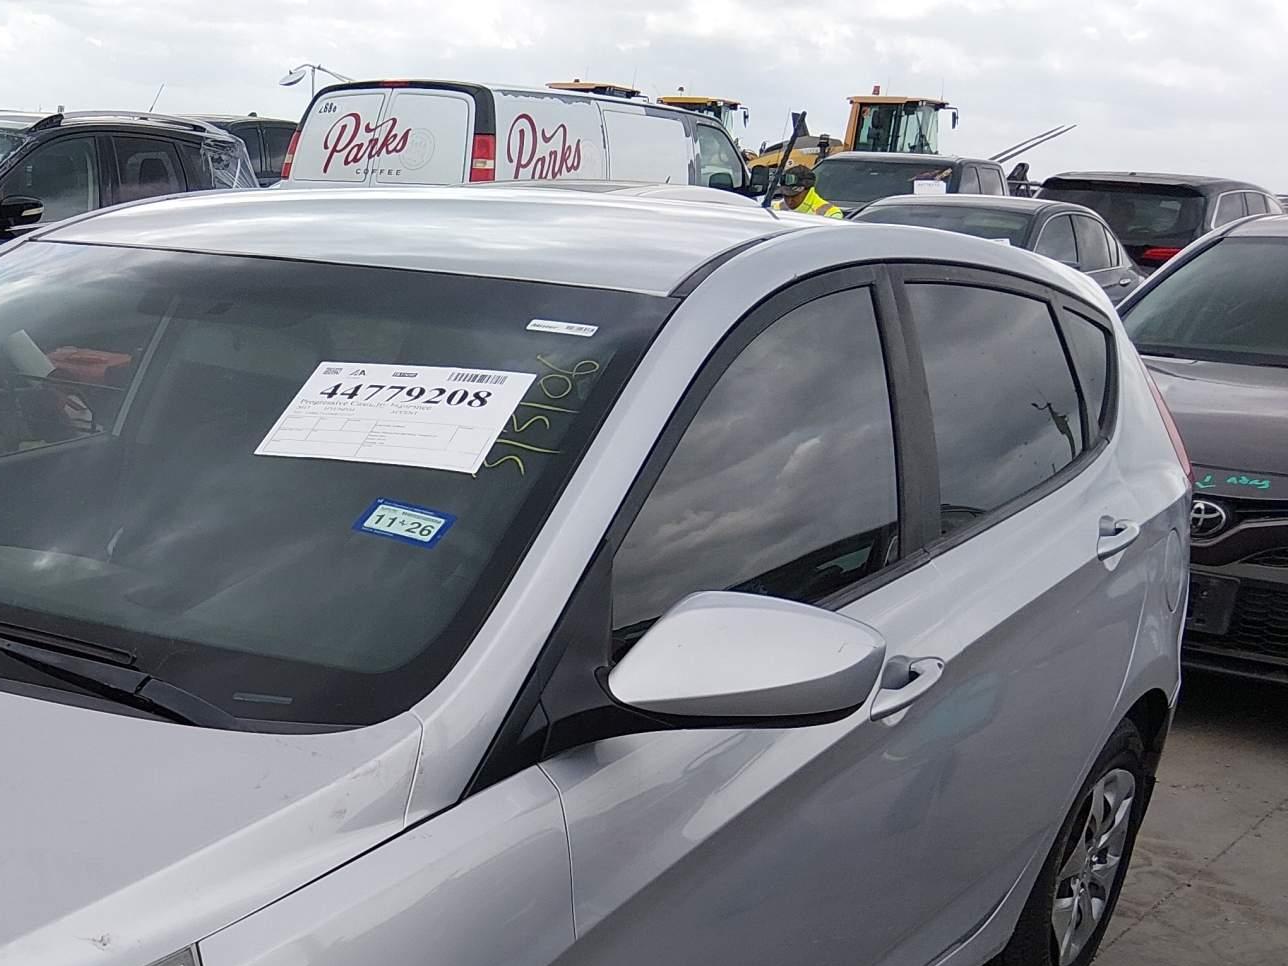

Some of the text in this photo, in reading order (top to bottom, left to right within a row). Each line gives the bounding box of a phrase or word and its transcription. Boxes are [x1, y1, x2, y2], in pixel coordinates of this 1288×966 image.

[323, 112, 412, 174] Parks
[506, 113, 581, 179] Parks
[355, 168, 402, 176] COFFEE
[320, 382, 493, 408] 44779208
